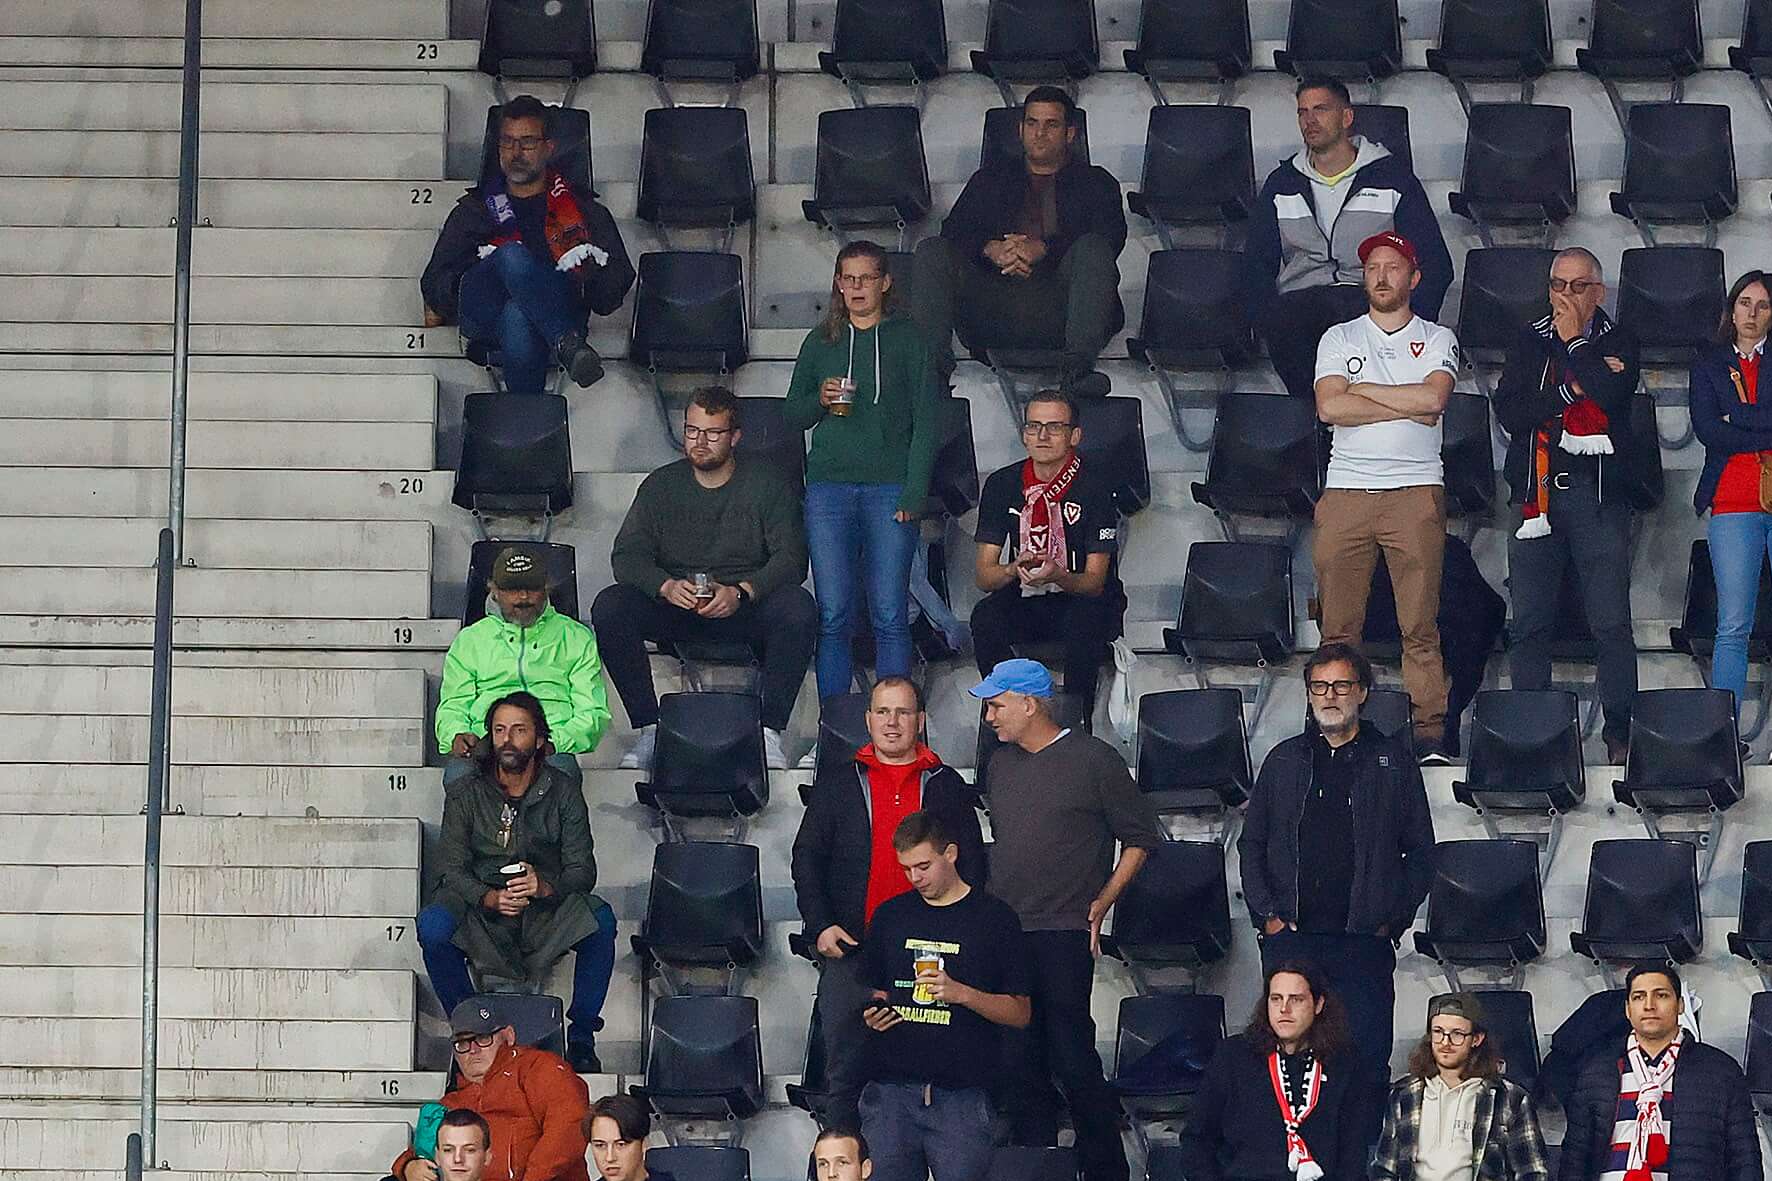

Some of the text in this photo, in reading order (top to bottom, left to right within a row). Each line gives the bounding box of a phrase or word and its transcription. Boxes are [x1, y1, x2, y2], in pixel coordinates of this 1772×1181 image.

[417, 43, 439, 60] 23
[410, 188, 433, 205] 22
[406, 333, 426, 349] 21
[400, 478, 424, 494] 20
[393, 627, 413, 645] 19
[388, 775, 407, 791] 18
[386, 926, 405, 942] 17
[380, 1080, 399, 1096] 16
